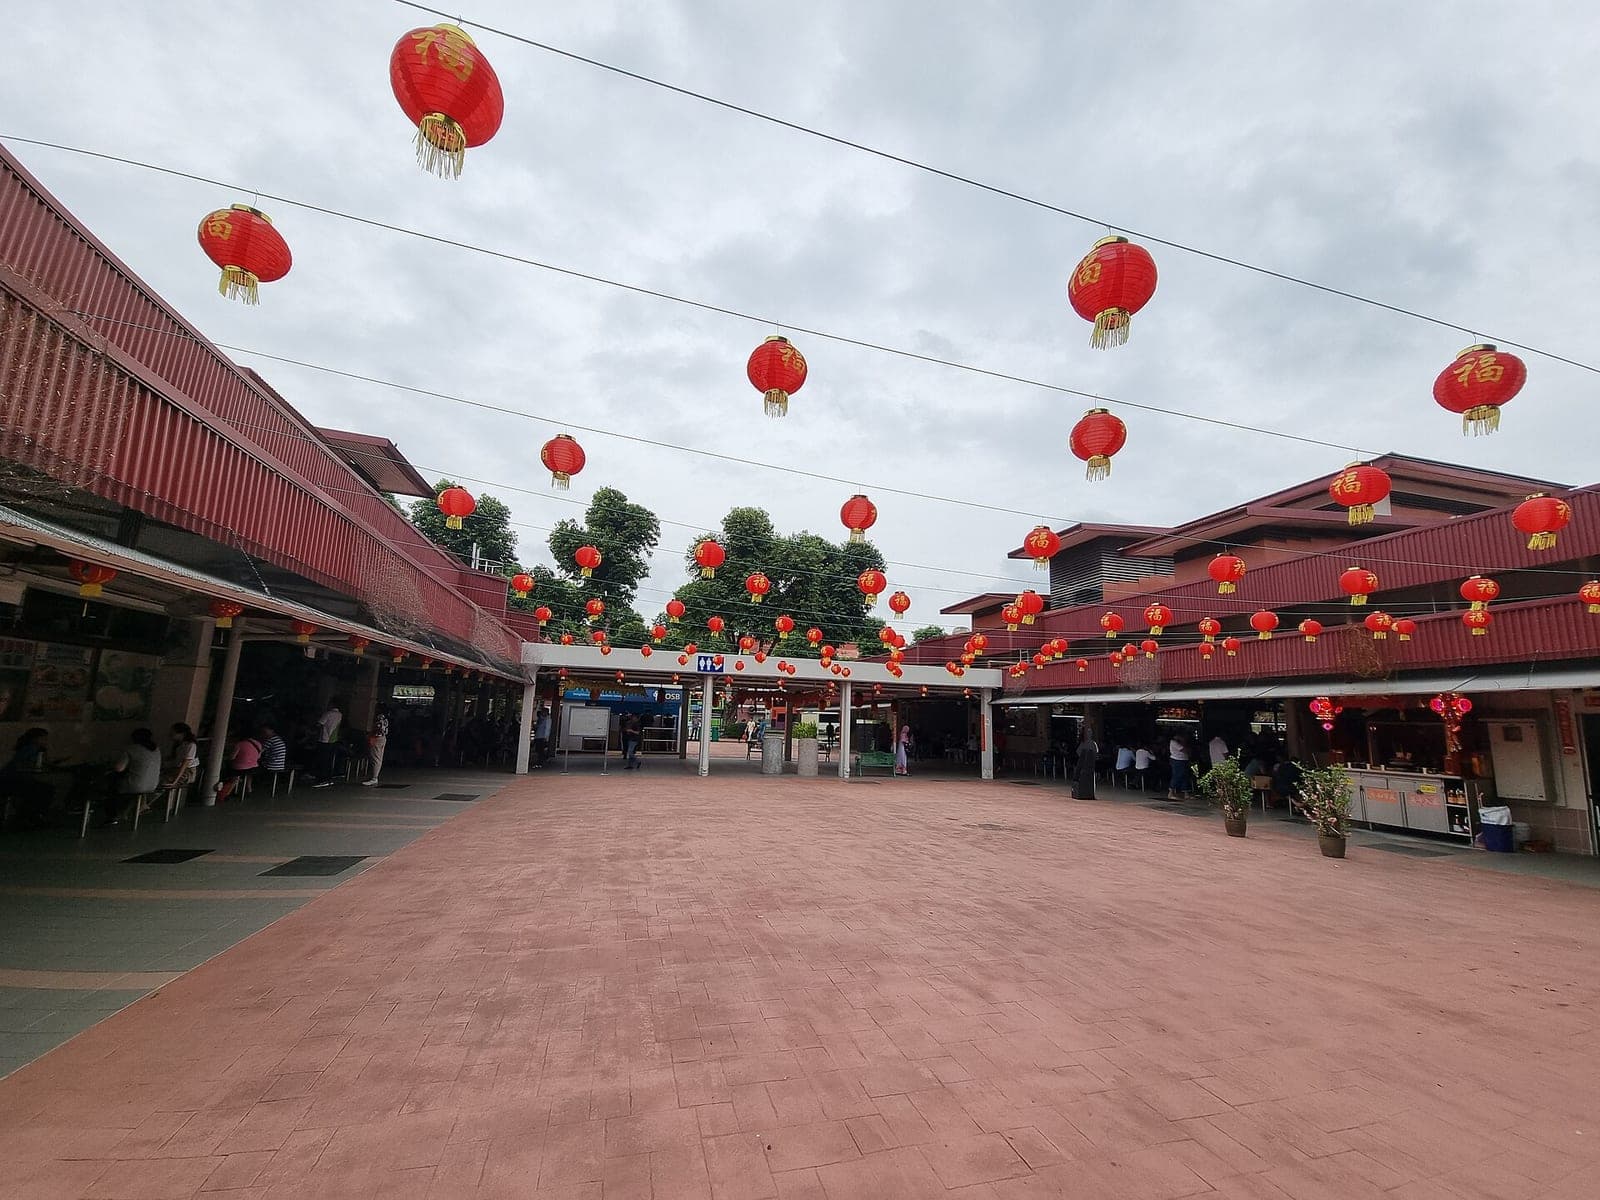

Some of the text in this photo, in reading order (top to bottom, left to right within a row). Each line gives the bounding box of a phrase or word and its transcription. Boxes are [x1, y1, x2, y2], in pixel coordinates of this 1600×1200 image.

[411, 31, 474, 81] 福
[779, 344, 806, 375] 福
[1453, 353, 1504, 388] 福
[1333, 471, 1361, 496] 福
[1030, 532, 1049, 549] 福
[753, 576, 766, 589] 福
[860, 573, 875, 587] 福
[1477, 581, 1496, 594] 福
[895, 596, 907, 607] 福
[1006, 606, 1019, 619] 福
[1148, 608, 1163, 622] 福
[1469, 613, 1485, 623] 福
[1200, 621, 1213, 632] 福
[1376, 614, 1391, 627] 福
